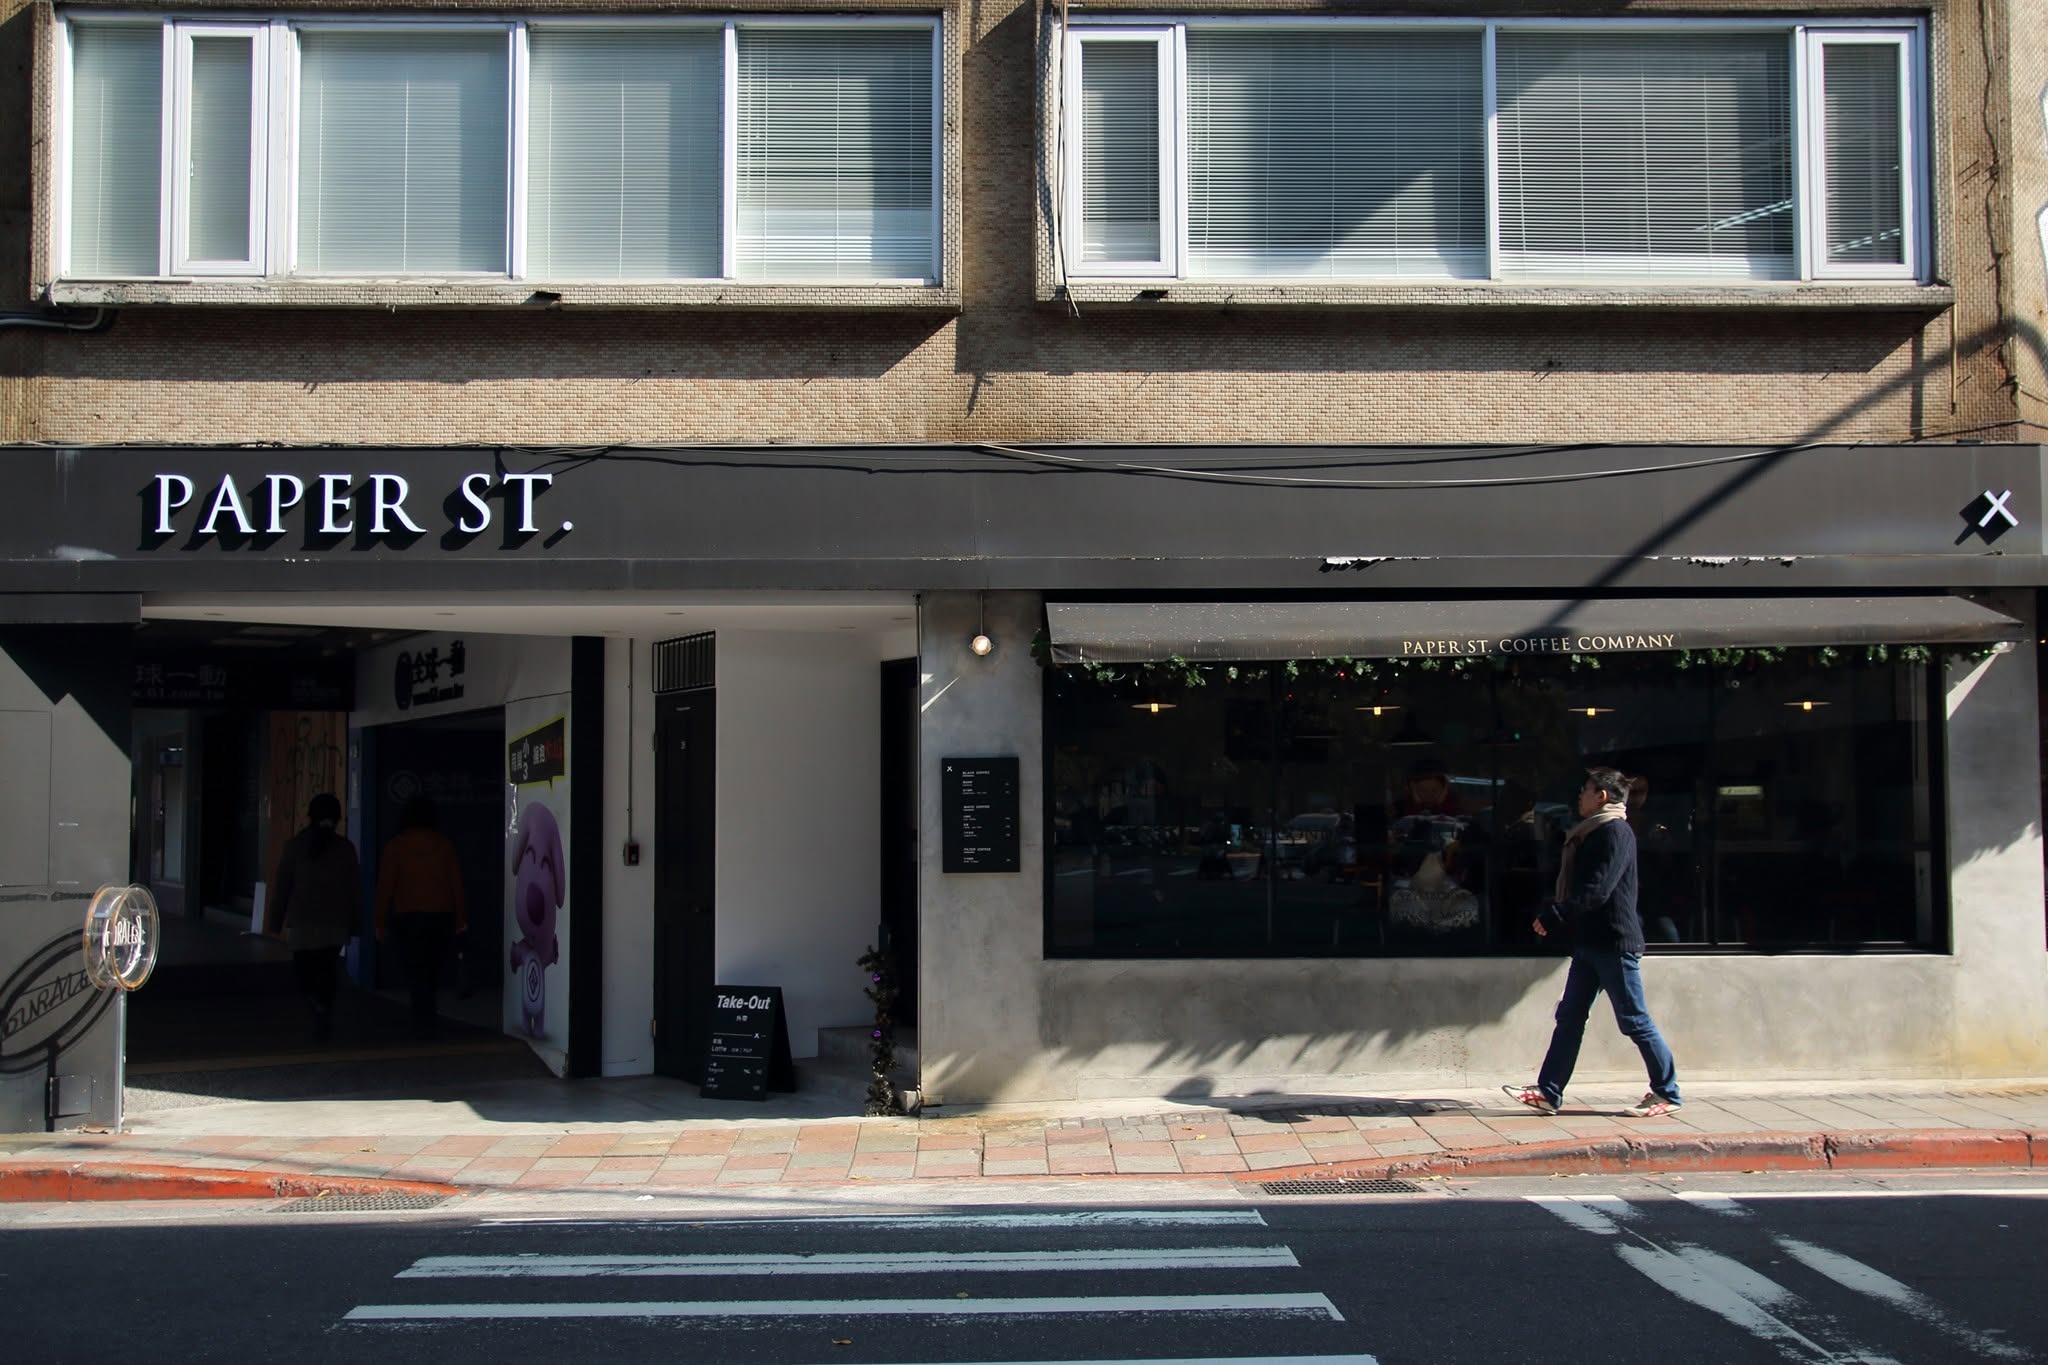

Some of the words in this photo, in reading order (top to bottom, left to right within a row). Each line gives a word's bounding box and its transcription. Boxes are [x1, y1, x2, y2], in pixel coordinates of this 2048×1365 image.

[154, 473, 427, 534] PAPER
[460, 473, 574, 534] ST.
[1403, 640, 1461, 655] PAPER
[1467, 639, 1492, 654] ST.
[1499, 637, 1571, 653] COFFEE
[1578, 634, 1675, 651] COMPANY
[717, 995, 771, 1010] Take-Out
